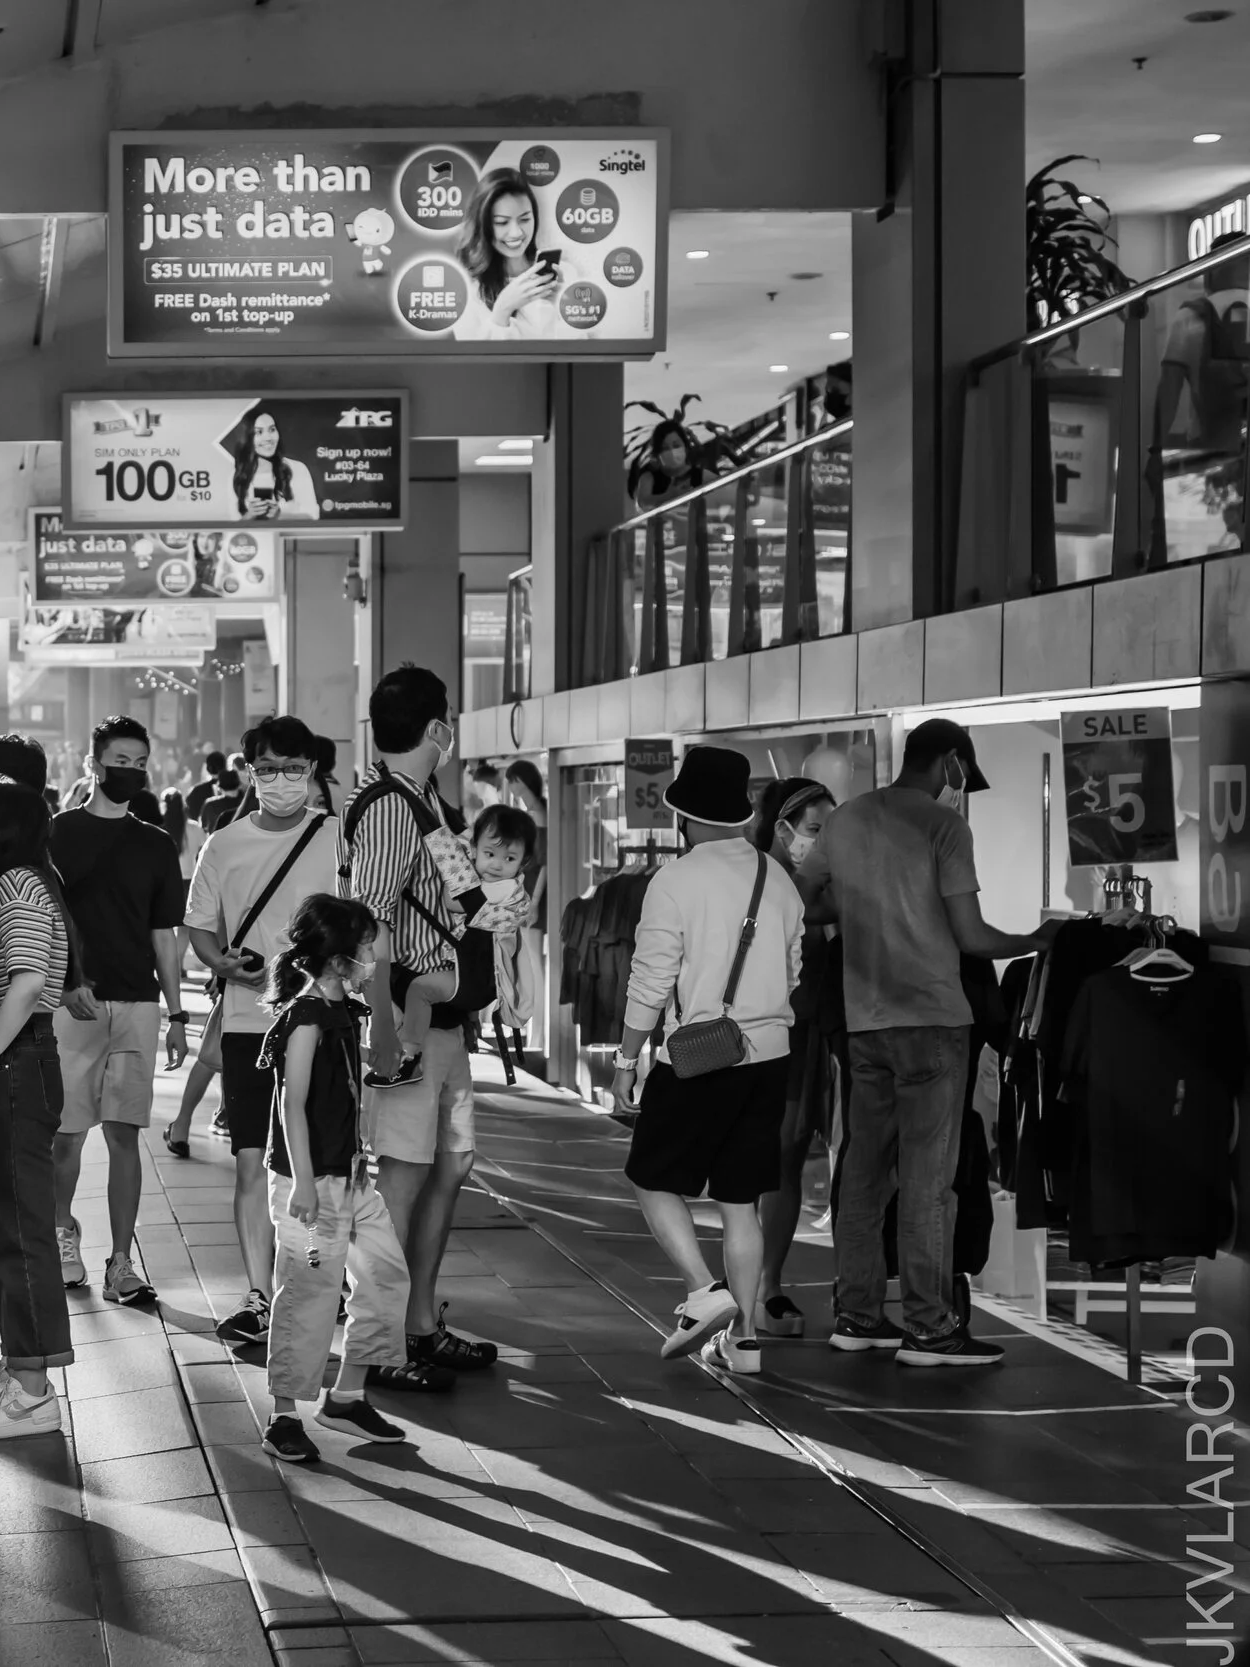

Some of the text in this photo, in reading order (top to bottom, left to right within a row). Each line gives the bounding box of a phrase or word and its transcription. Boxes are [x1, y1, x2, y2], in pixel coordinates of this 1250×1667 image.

[144, 153, 371, 194] More than
[599, 159, 646, 175] Singtel
[417, 186, 462, 207] 300
[417, 208, 464, 217] IDD mins
[561, 207, 615, 225] 60GB
[139, 199, 335, 251] just data
[1188, 193, 1250, 261] OUTL
[150, 261, 326, 279] $35 ULTIMATE PLAN
[611, 266, 635, 274] DATA
[154, 293, 195, 308] FREE
[198, 292, 237, 308] Dash
[409, 291, 457, 307] FREE
[190, 308, 295, 326] on 1st top-up
[408, 309, 458, 320] K-Dramas
[588, 305, 601, 315] #1
[94, 448, 181, 458] SIM ONLY PLAN
[316, 445, 392, 460] Sign up now!
[335, 460, 370, 471] #03-64
[95, 459, 211, 502] 100 GB
[324, 471, 384, 483] Lucky Plaza
[190, 490, 212, 502] $10
[39, 534, 127, 559] just data
[1083, 713, 1148, 738] SALE
[629, 751, 671, 767] OUTLET
[634, 782, 660, 810] $5
[1083, 772, 1146, 834] $5
